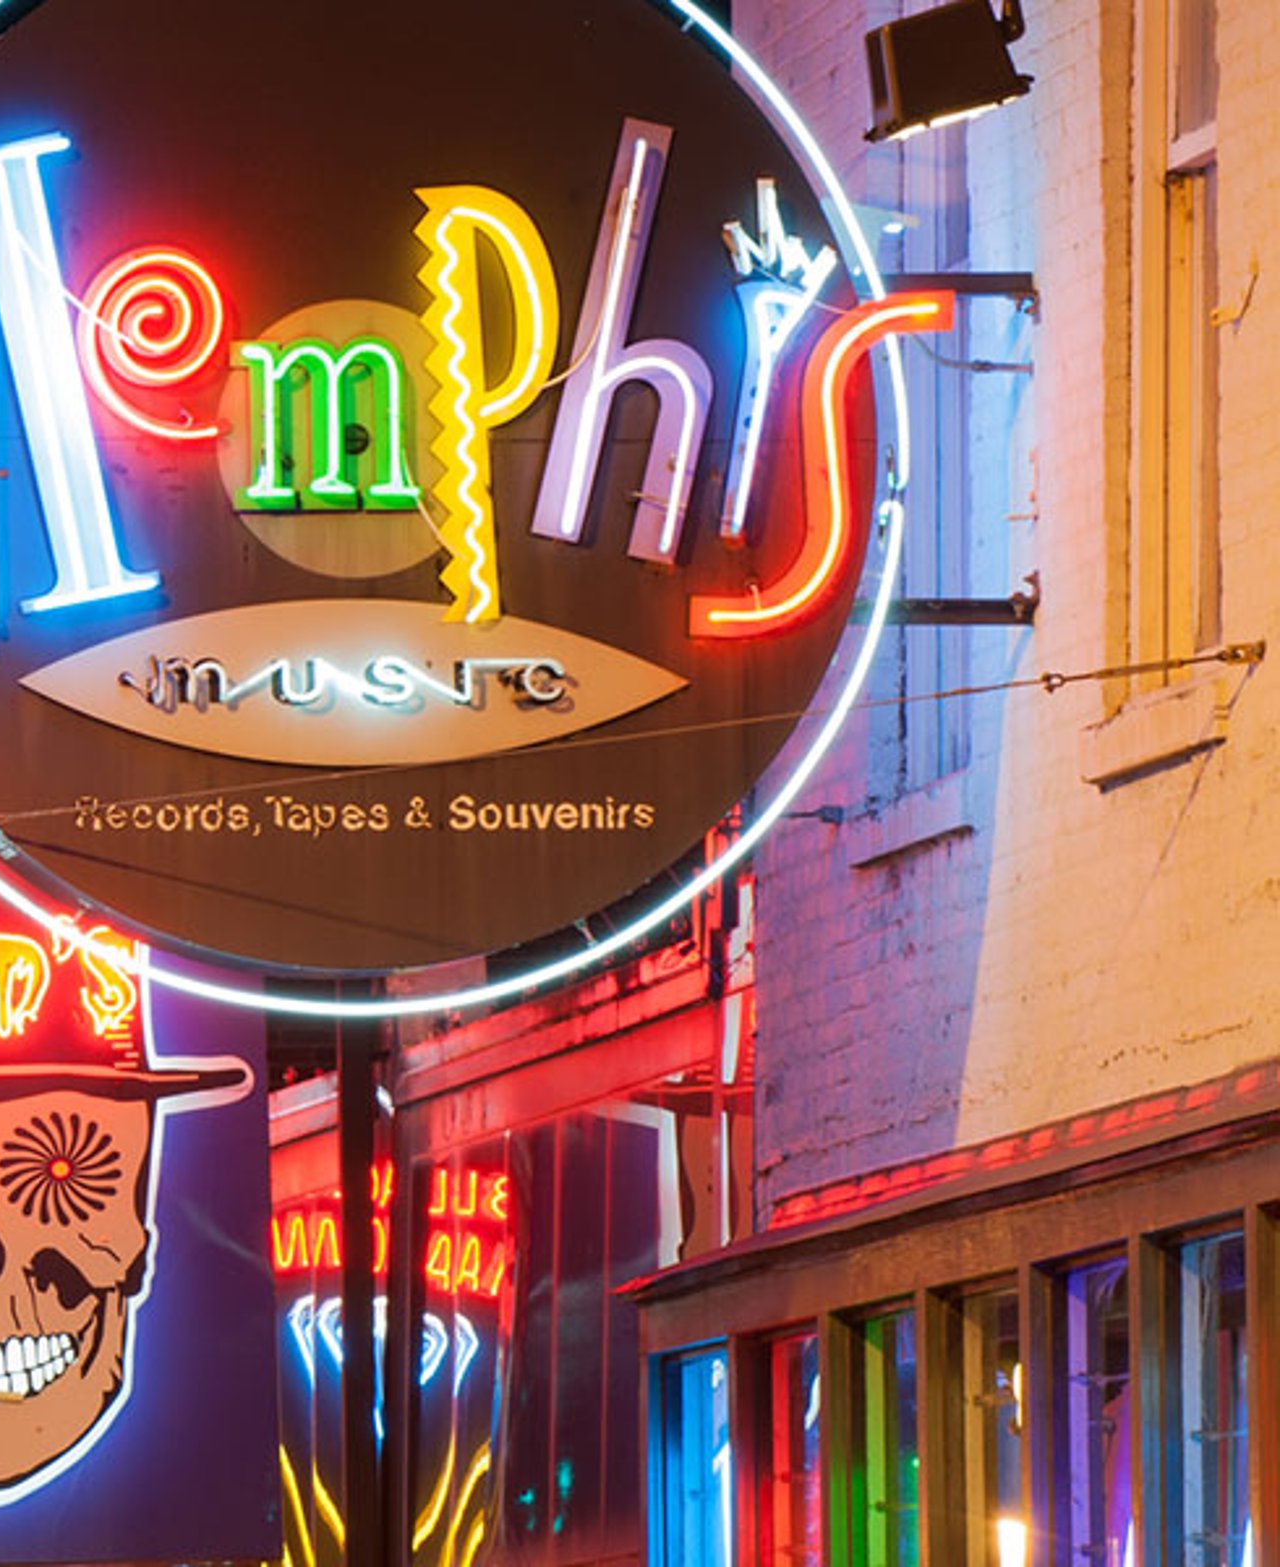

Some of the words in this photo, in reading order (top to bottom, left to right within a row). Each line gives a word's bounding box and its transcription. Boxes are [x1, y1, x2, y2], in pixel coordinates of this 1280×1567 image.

[117, 654, 574, 710] music
[404, 796, 433, 829] &
[448, 795, 656, 831] Souvenirs
